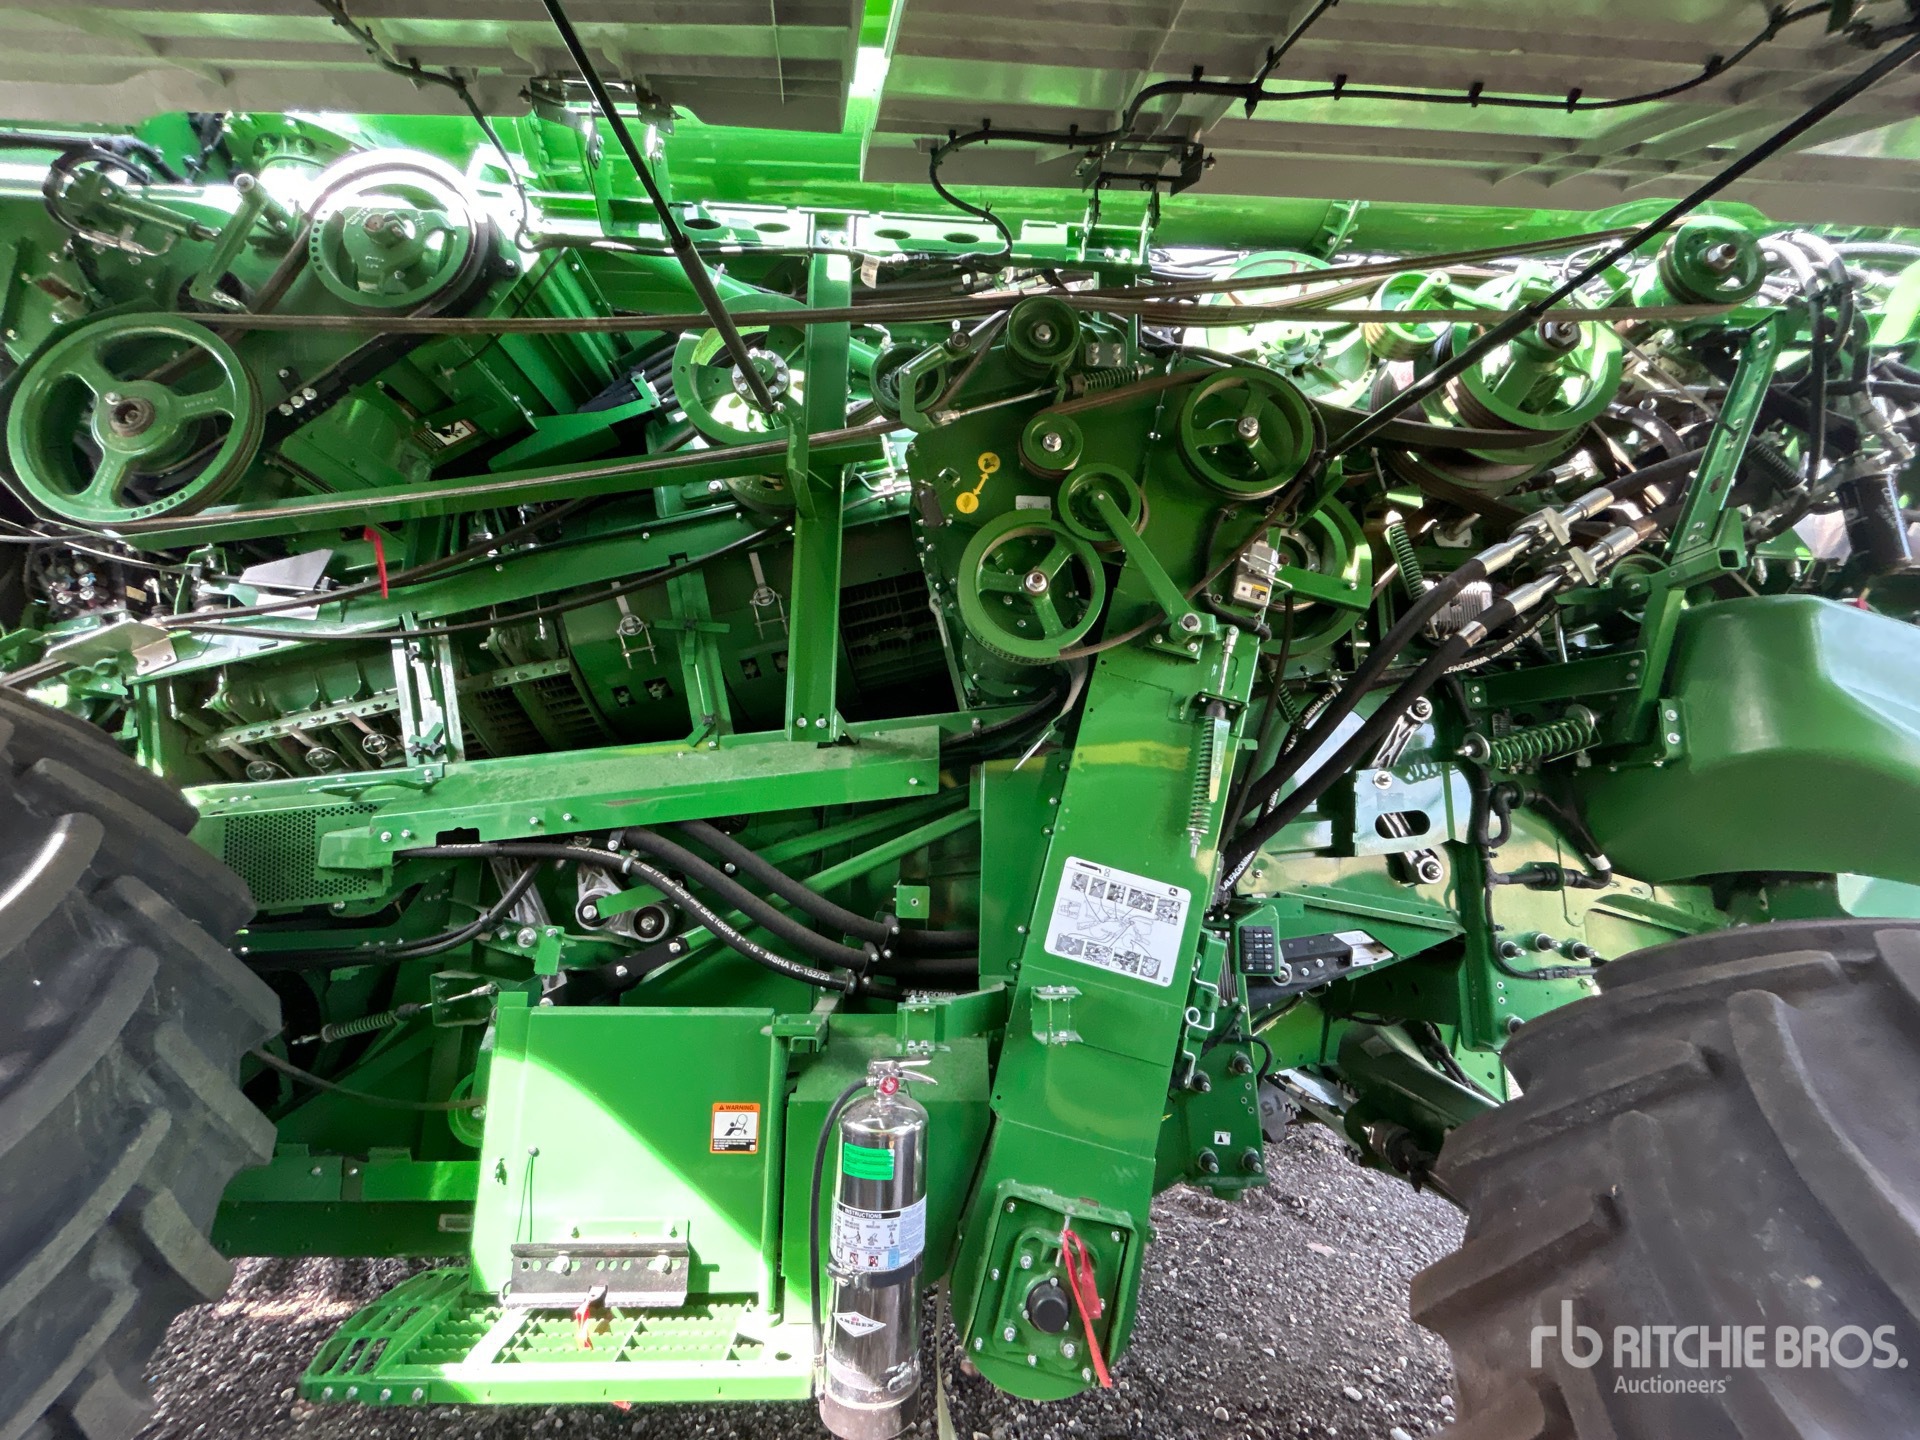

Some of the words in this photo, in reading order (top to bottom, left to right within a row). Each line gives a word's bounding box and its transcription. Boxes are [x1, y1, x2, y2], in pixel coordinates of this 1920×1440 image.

[1304, 700, 1324, 719] MSHA
[700, 906, 736, 938] SAE100R4
[764, 952, 790, 968] MSHA
[791, 964, 830, 981] IC-152/23
[844, 1207, 882, 1219] INSTRUCTIONS
